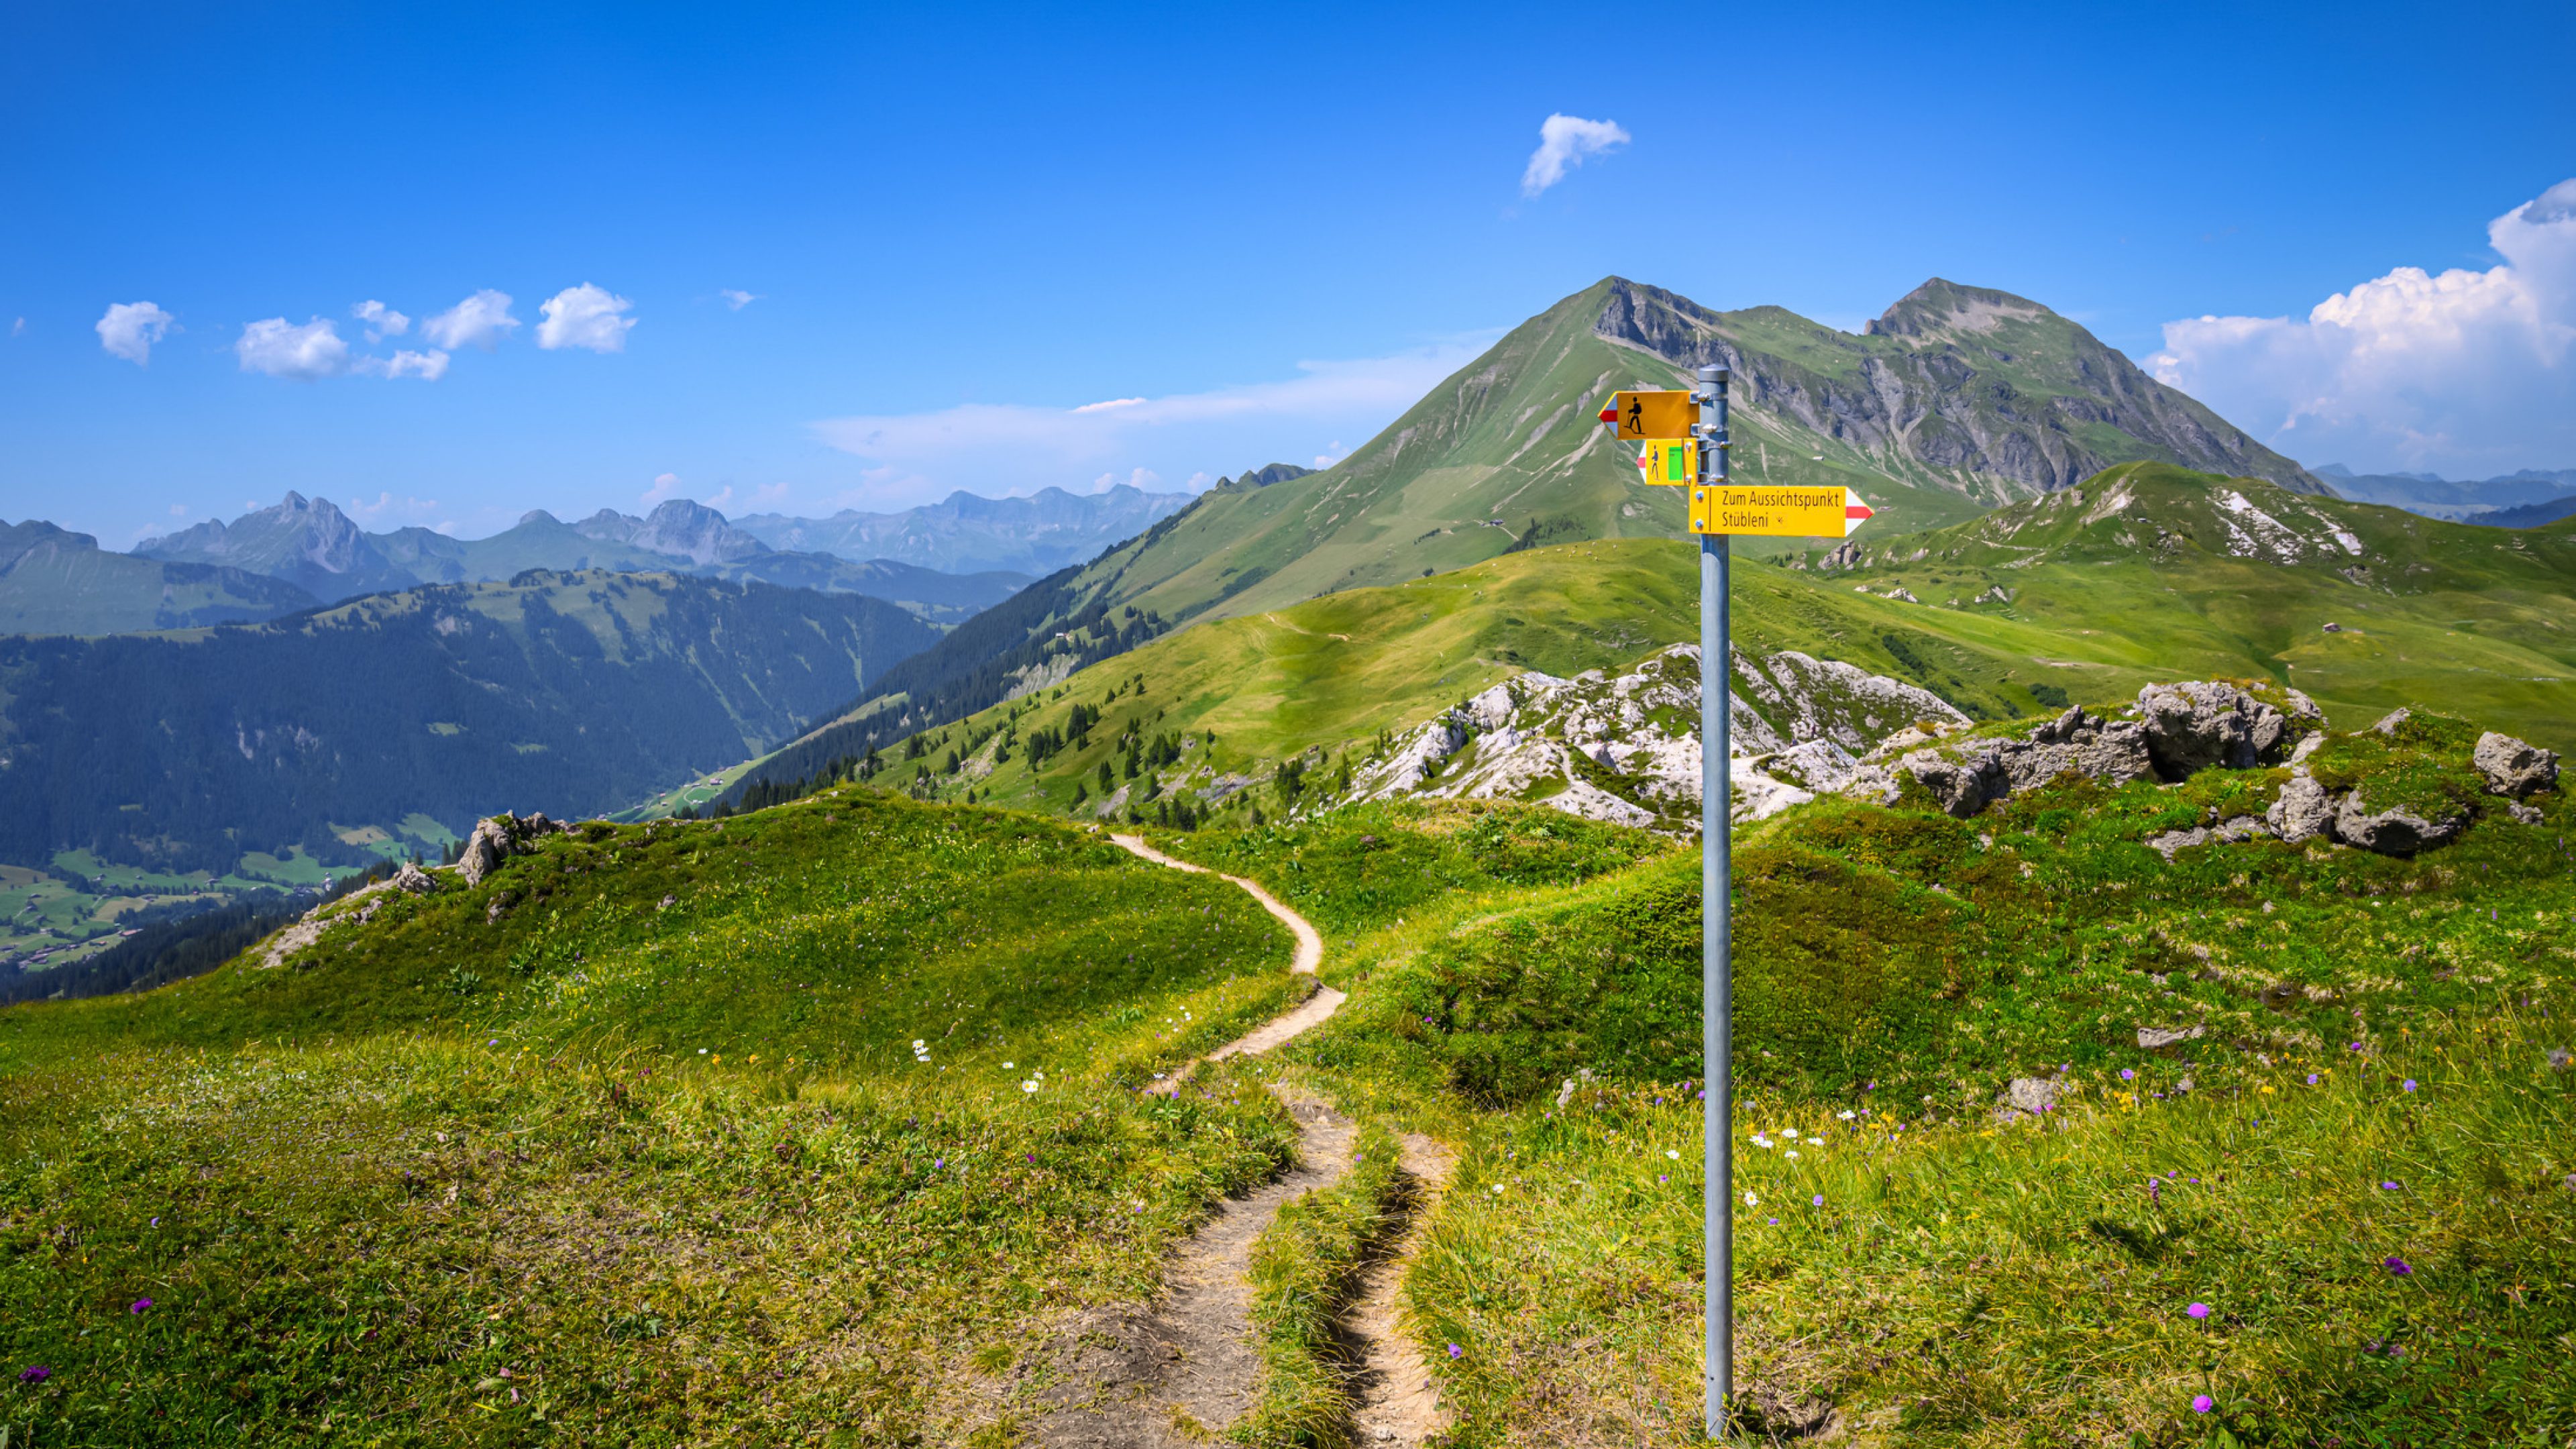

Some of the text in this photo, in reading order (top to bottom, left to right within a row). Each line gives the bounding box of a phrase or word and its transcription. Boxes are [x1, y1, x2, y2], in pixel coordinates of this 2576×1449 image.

[1723, 490, 1839, 511] Zum Aussichtspunkt
[1723, 512, 1768, 527] Stübleni
